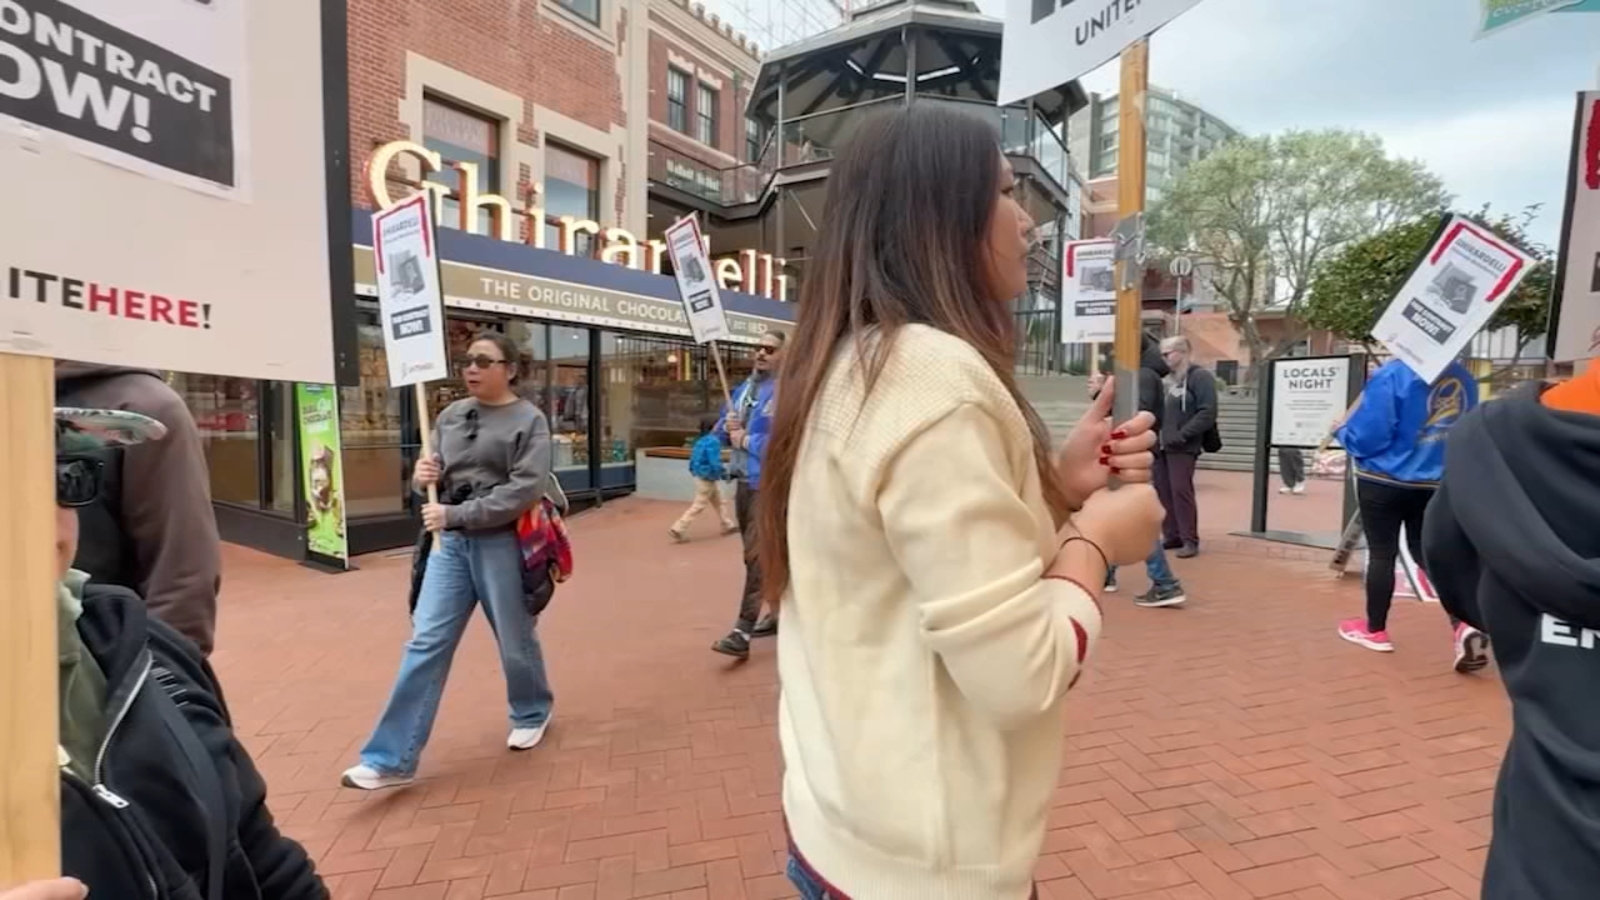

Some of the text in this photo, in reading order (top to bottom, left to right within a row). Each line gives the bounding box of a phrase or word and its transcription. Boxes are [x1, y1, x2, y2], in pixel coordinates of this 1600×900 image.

[1075, 0, 1141, 46] UNITE
[0, 0, 216, 112] ONTRACT
[9, 266, 212, 329] ITEHERE!
[480, 277, 521, 300] THE
[527, 286, 612, 314] ORIGINAL
[616, 299, 689, 326] CHOCOLA
[1288, 379, 1334, 390] NIGHT
